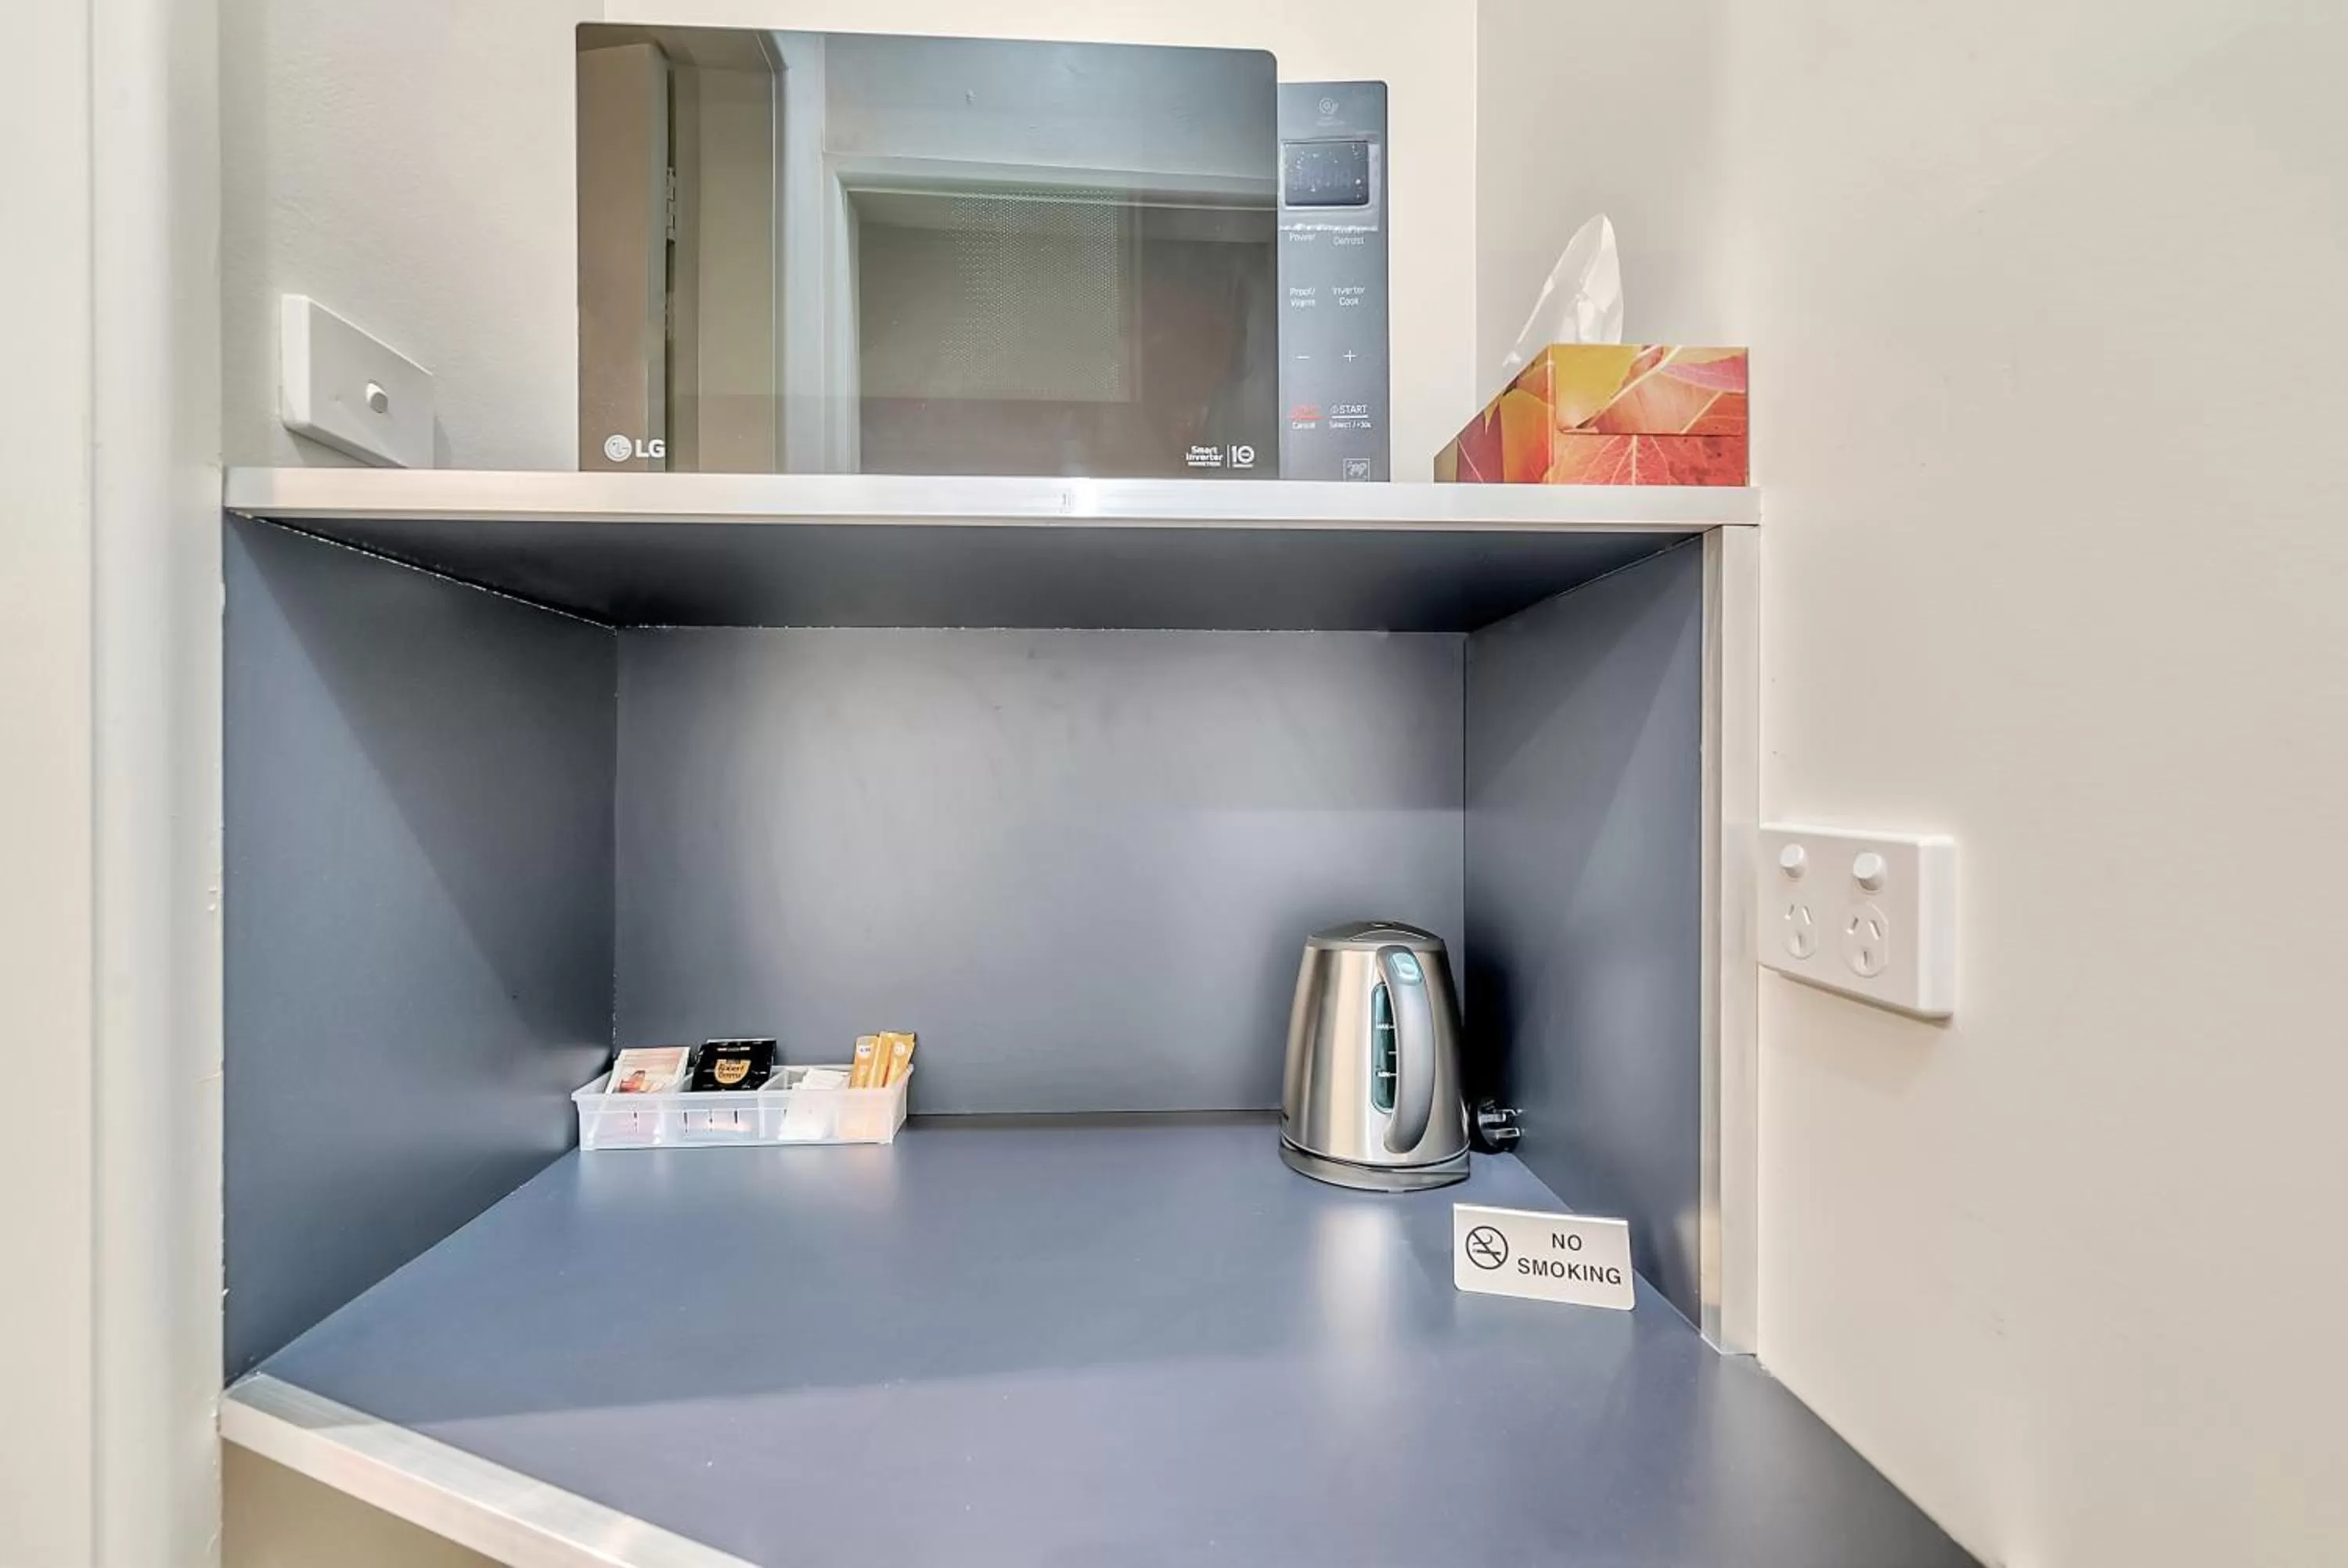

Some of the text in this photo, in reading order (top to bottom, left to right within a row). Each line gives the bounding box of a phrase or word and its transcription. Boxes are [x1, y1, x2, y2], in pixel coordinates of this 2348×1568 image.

[1339, 405, 1367, 414] START
[635, 439, 666, 458] LG
[1191, 445, 1218, 454] Smart
[1552, 1233, 1583, 1251] NO
[1518, 1257, 1622, 1285] SMOKING
